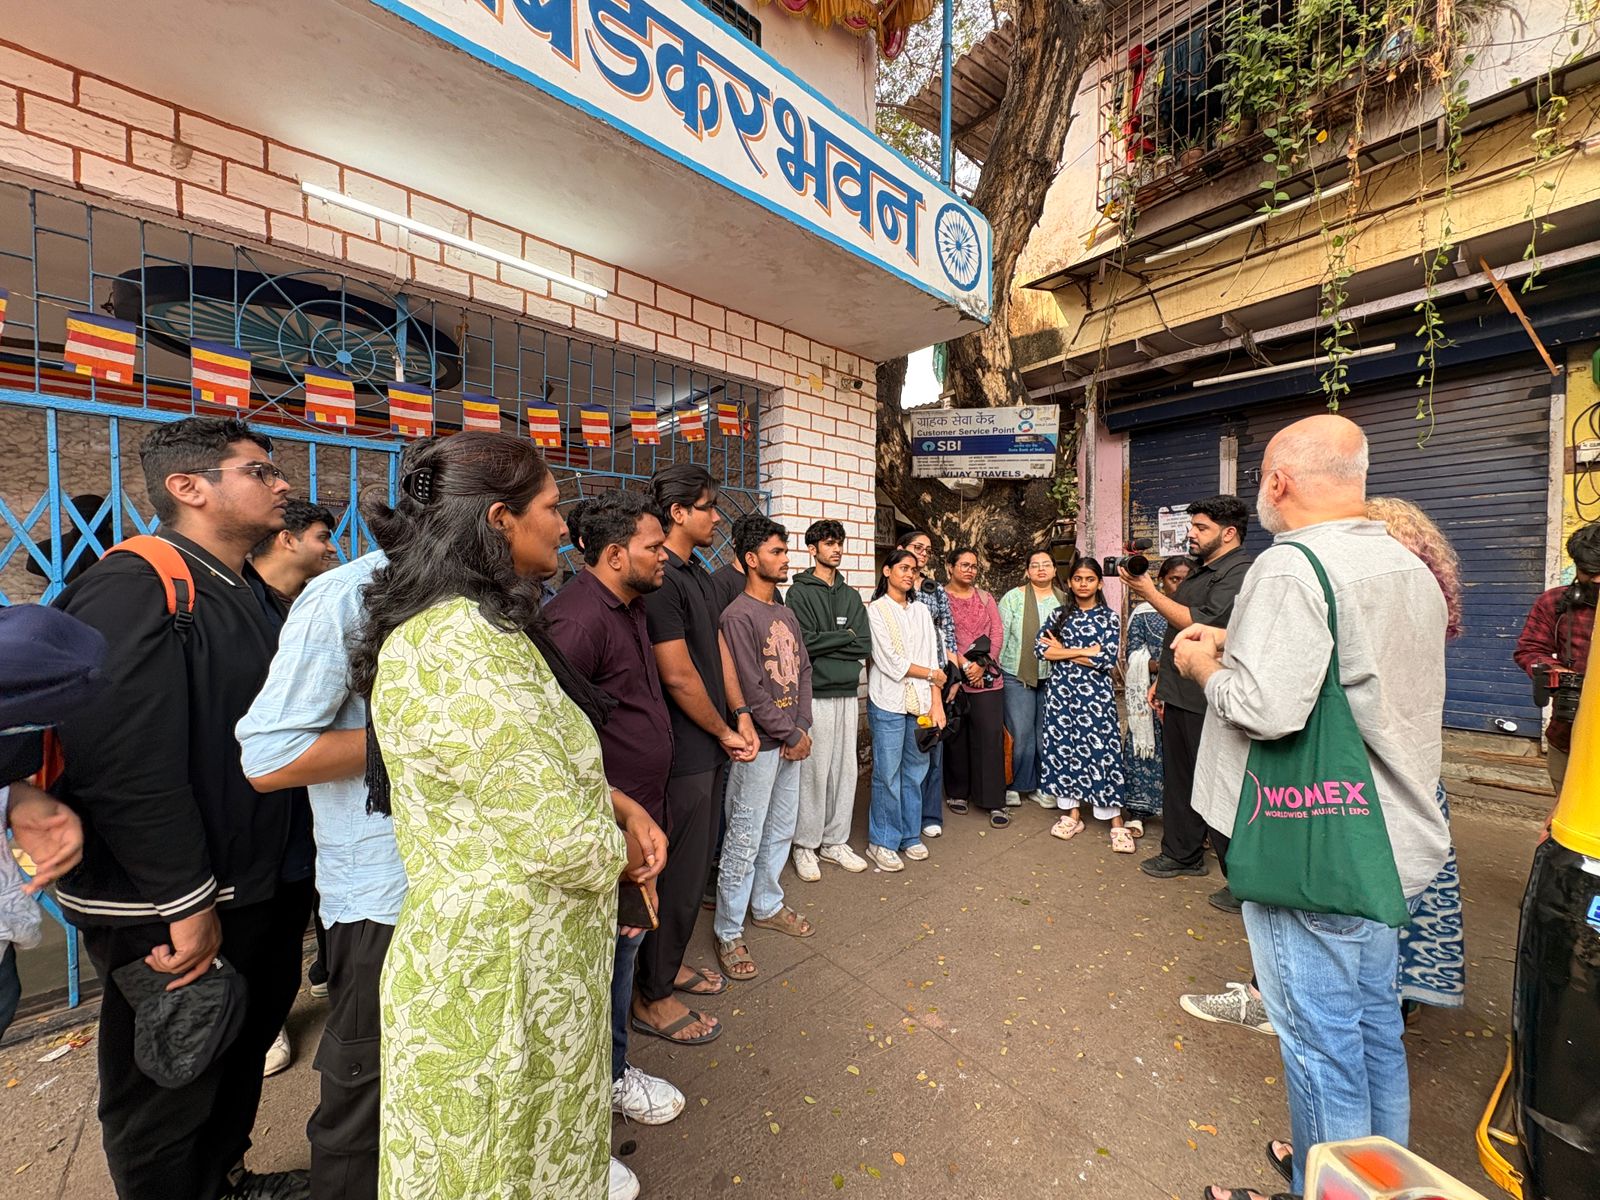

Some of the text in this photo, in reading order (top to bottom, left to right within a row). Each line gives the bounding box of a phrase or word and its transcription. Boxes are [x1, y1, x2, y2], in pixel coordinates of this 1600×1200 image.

[772, 97, 926, 265] भवन
[917, 415, 948, 428] ग्राहक
[951, 412, 973, 426] सेवा
[916, 426, 1015, 437] Customer Service Point
[937, 440, 962, 452] SBI
[943, 470, 972, 478] VIJAY
[974, 470, 1022, 478] TRAVELS
[1263, 781, 1369, 809] WOMEX
[1264, 810, 1309, 819] WORLDWIDE
[1311, 807, 1338, 816] MUSIC
[1349, 808, 1370, 816] EXPO
